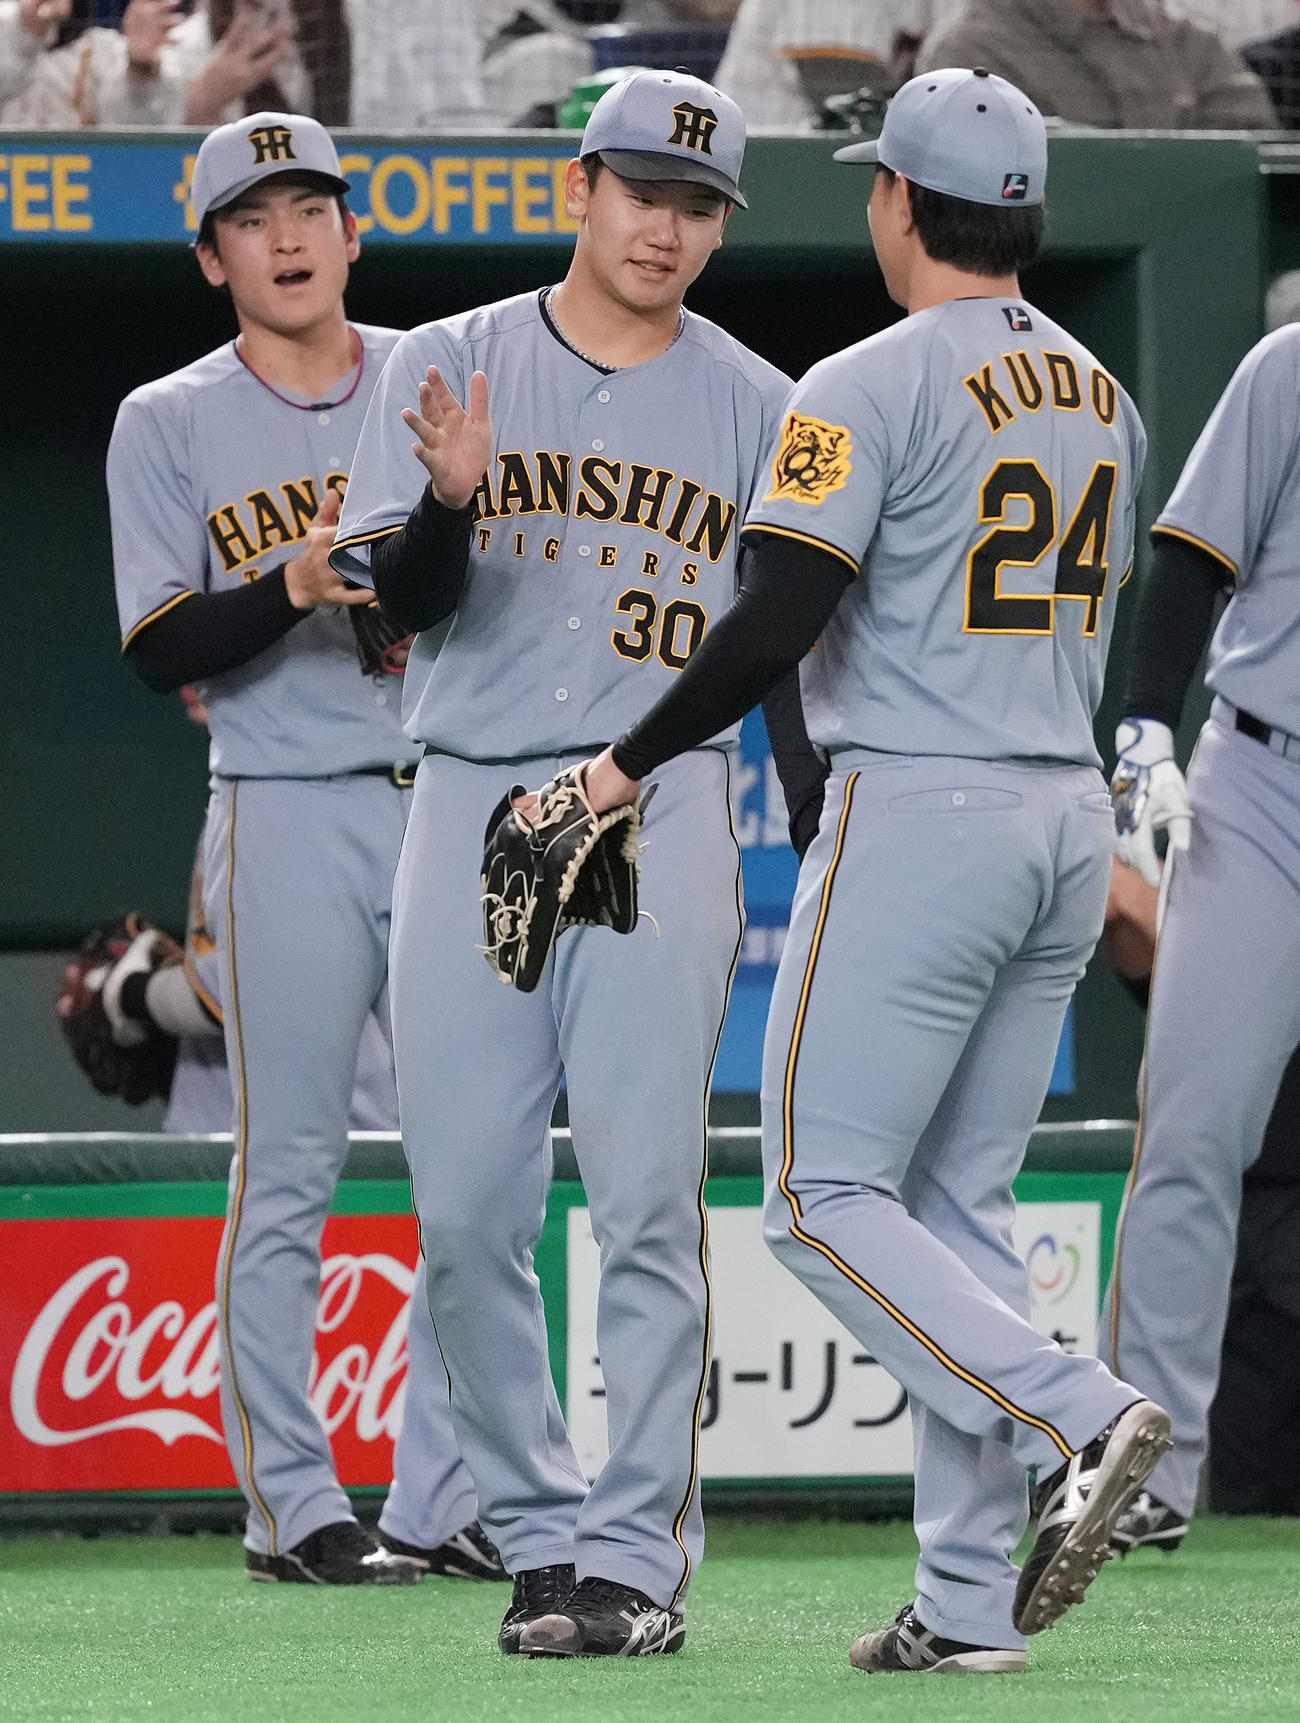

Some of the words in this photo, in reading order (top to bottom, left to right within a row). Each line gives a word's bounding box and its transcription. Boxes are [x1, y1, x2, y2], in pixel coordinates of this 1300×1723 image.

[0, 153, 93, 232] EE
[963, 350, 1118, 435] KUDO
[477, 528, 699, 586] TIGERS
[963, 458, 1119, 637] 24
[611, 588, 709, 671] 30
